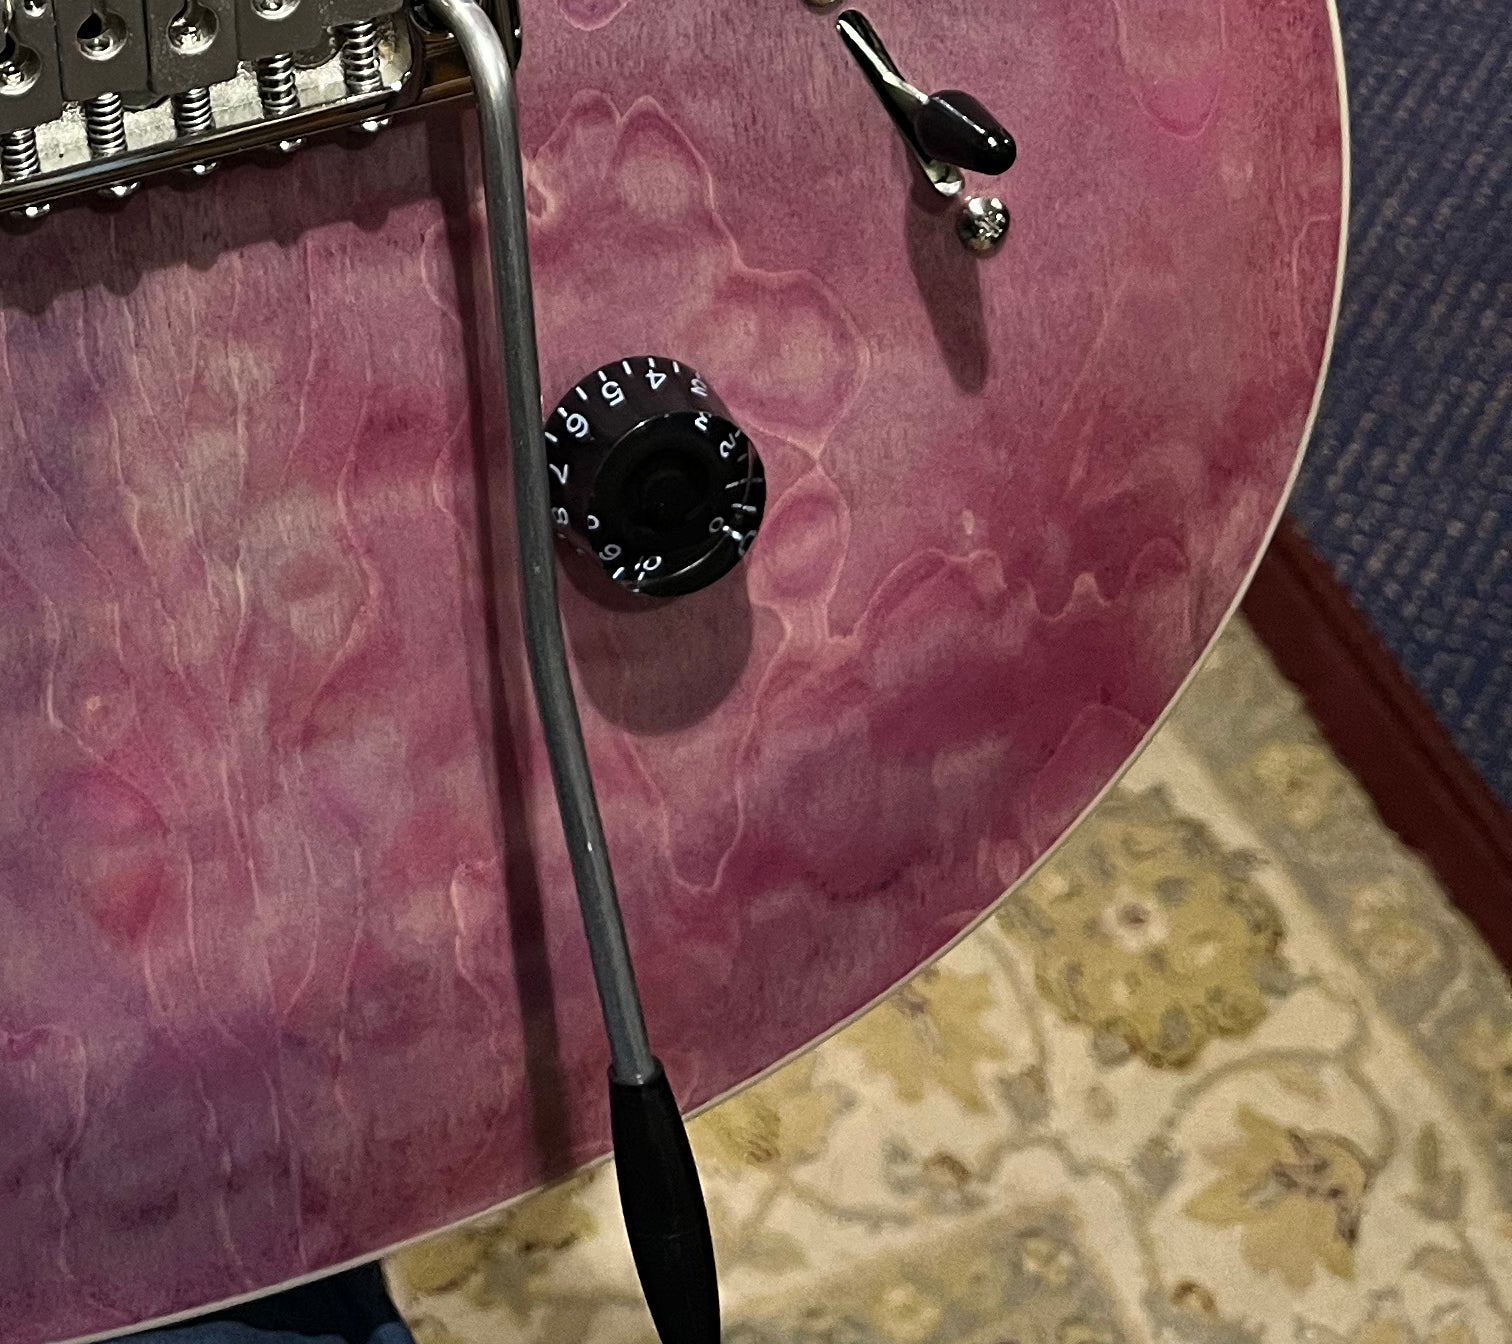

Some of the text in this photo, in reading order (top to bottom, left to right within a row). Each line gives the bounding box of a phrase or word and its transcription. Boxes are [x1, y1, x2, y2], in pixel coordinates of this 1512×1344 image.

[645, 369, 667, 390] 4
[600, 381, 626, 407] 5
[549, 463, 569, 485] 7
